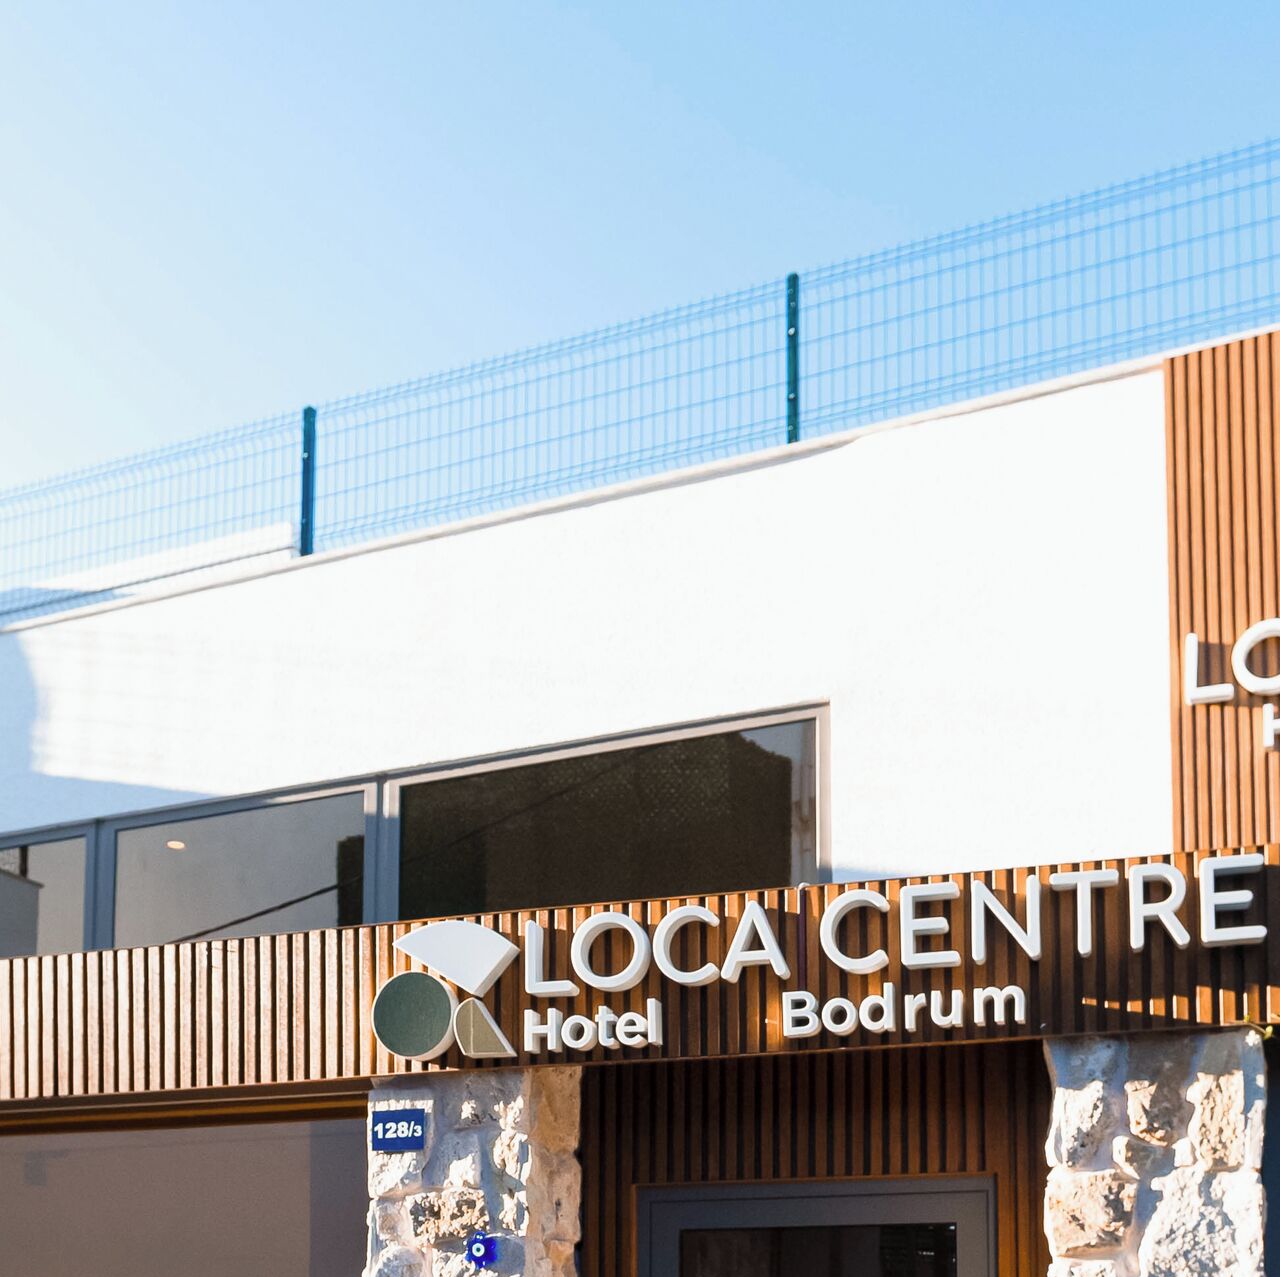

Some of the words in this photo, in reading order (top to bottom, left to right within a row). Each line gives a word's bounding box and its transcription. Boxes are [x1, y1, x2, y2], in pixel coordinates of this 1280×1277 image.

[524, 899, 791, 997] LOCA
[820, 853, 1268, 975] CENTRE
[524, 997, 663, 1054] Hotel
[782, 982, 1026, 1040] Bodrum
[373, 1121, 423, 1140] 128/3
